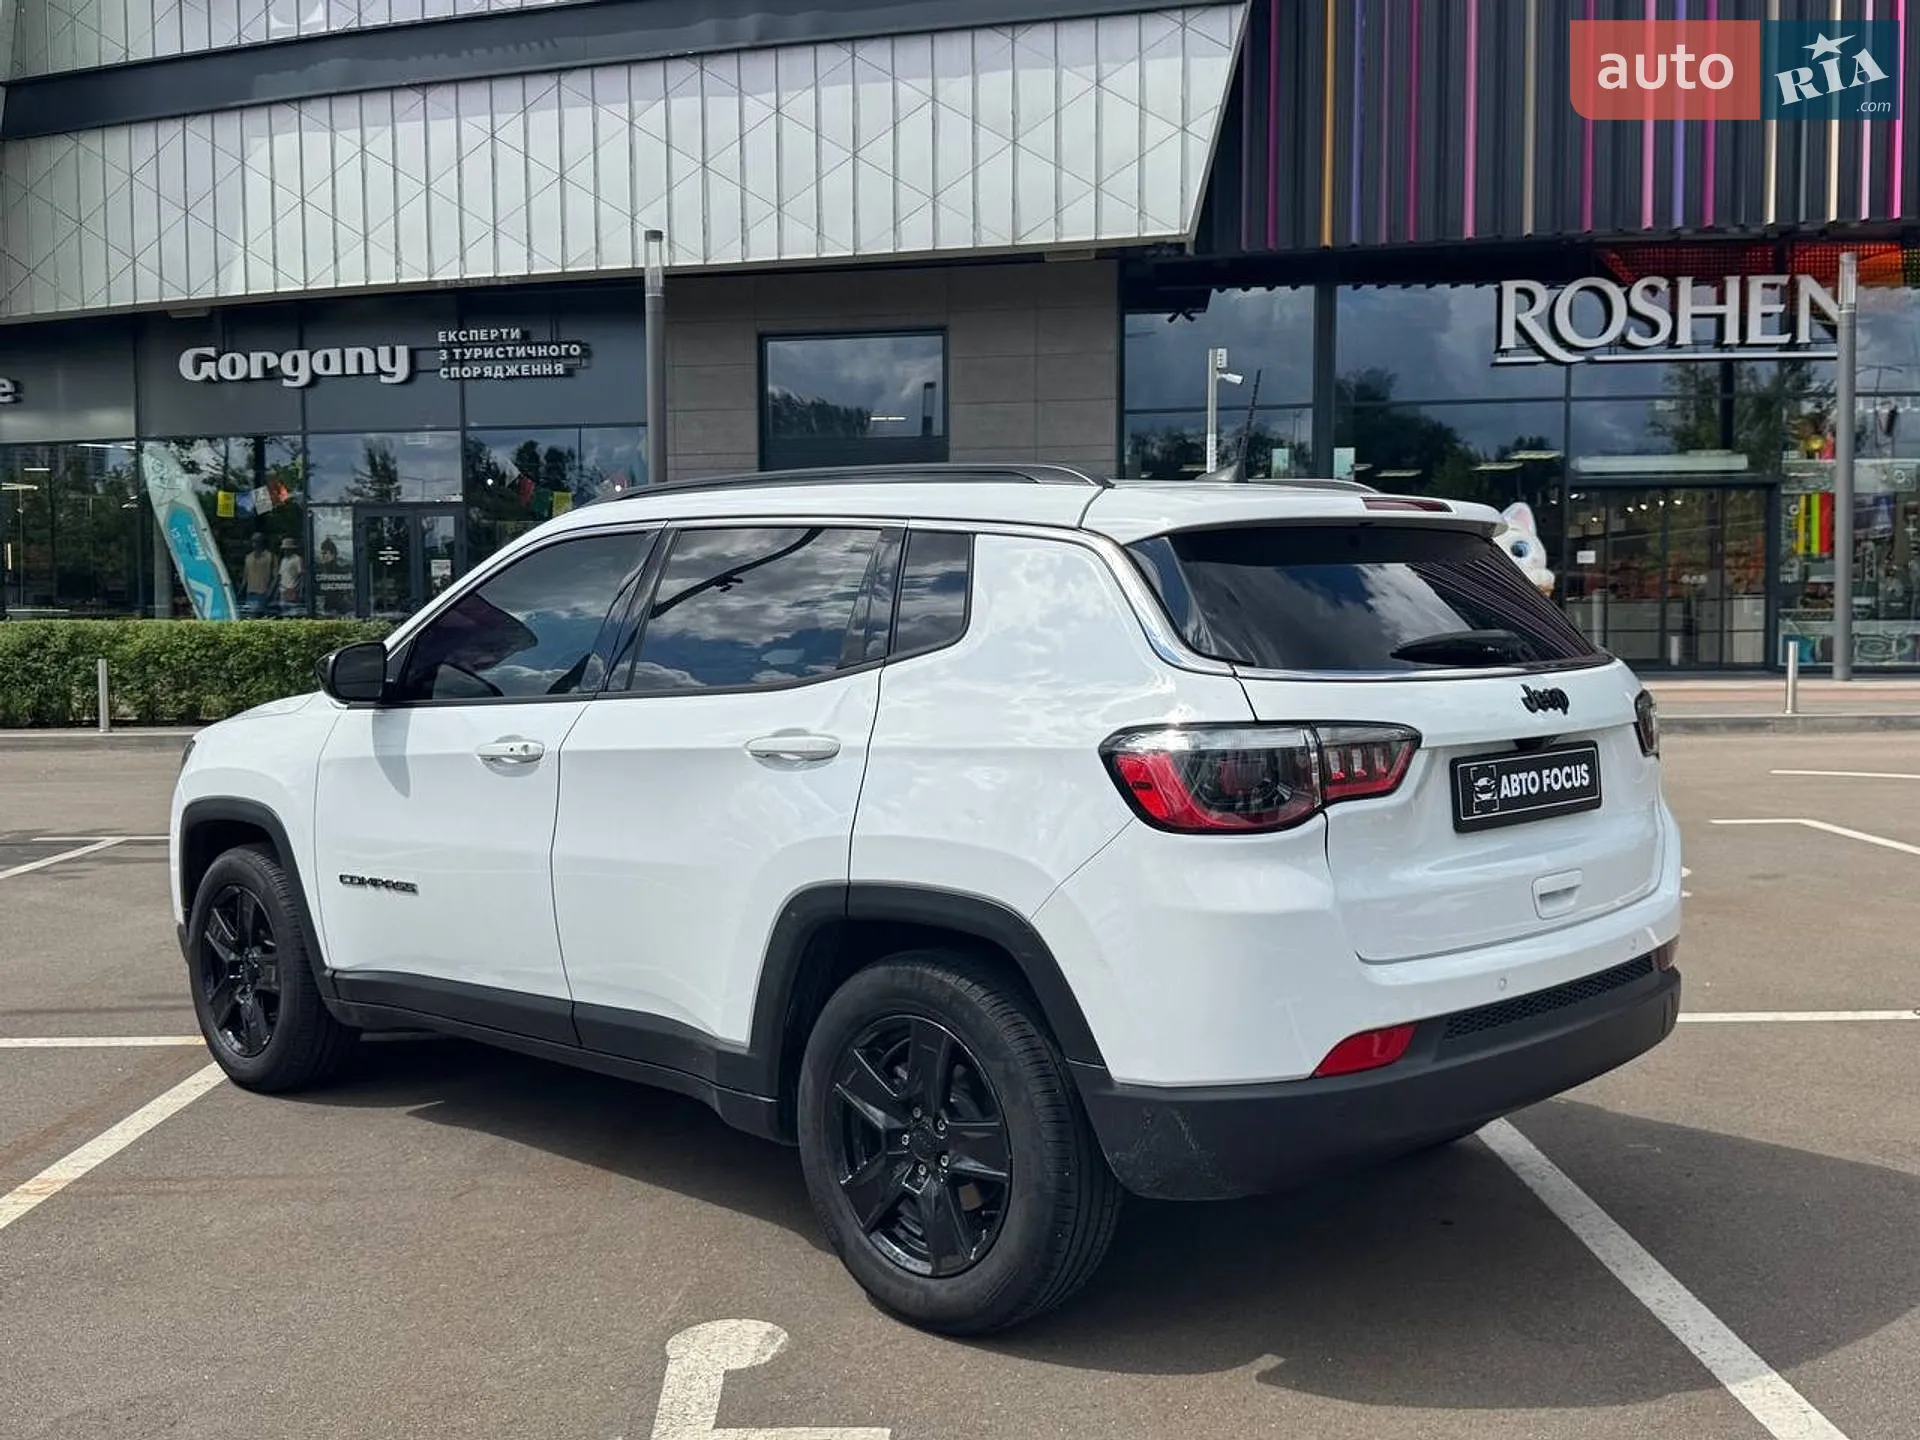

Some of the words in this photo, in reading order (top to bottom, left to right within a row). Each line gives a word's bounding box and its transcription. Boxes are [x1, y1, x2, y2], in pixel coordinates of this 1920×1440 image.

[1497, 274, 1841, 362] ROSHEN
[437, 328, 522, 342] ЕКСПЕРТИ
[178, 345, 409, 387] Gorgany
[453, 344, 582, 360] ТУРИСТИЧНОГО
[439, 363, 565, 379] СПОРЯДЖЕННЯ
[1520, 683, 1570, 716] Jeep
[1542, 763, 1590, 793] FOCUS
